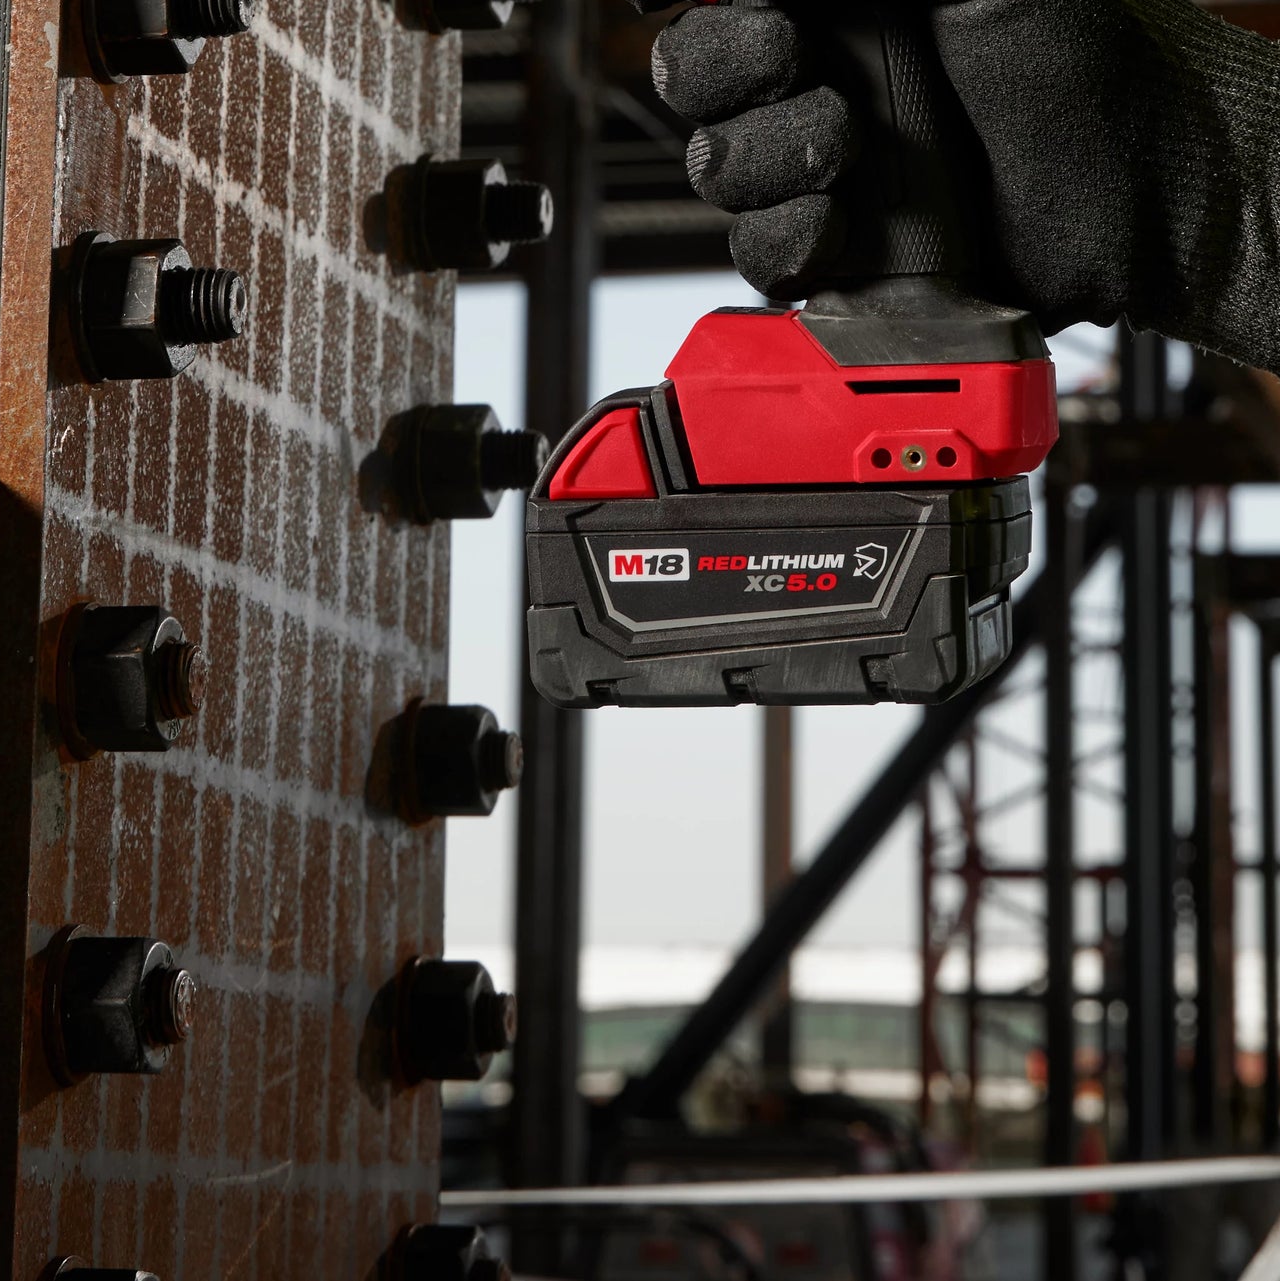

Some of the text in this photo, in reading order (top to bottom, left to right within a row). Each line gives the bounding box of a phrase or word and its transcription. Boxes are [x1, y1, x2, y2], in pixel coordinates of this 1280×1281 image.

[614, 553, 845, 576] M18 REDLITHIUM
[743, 572, 838, 592] XC5.0
